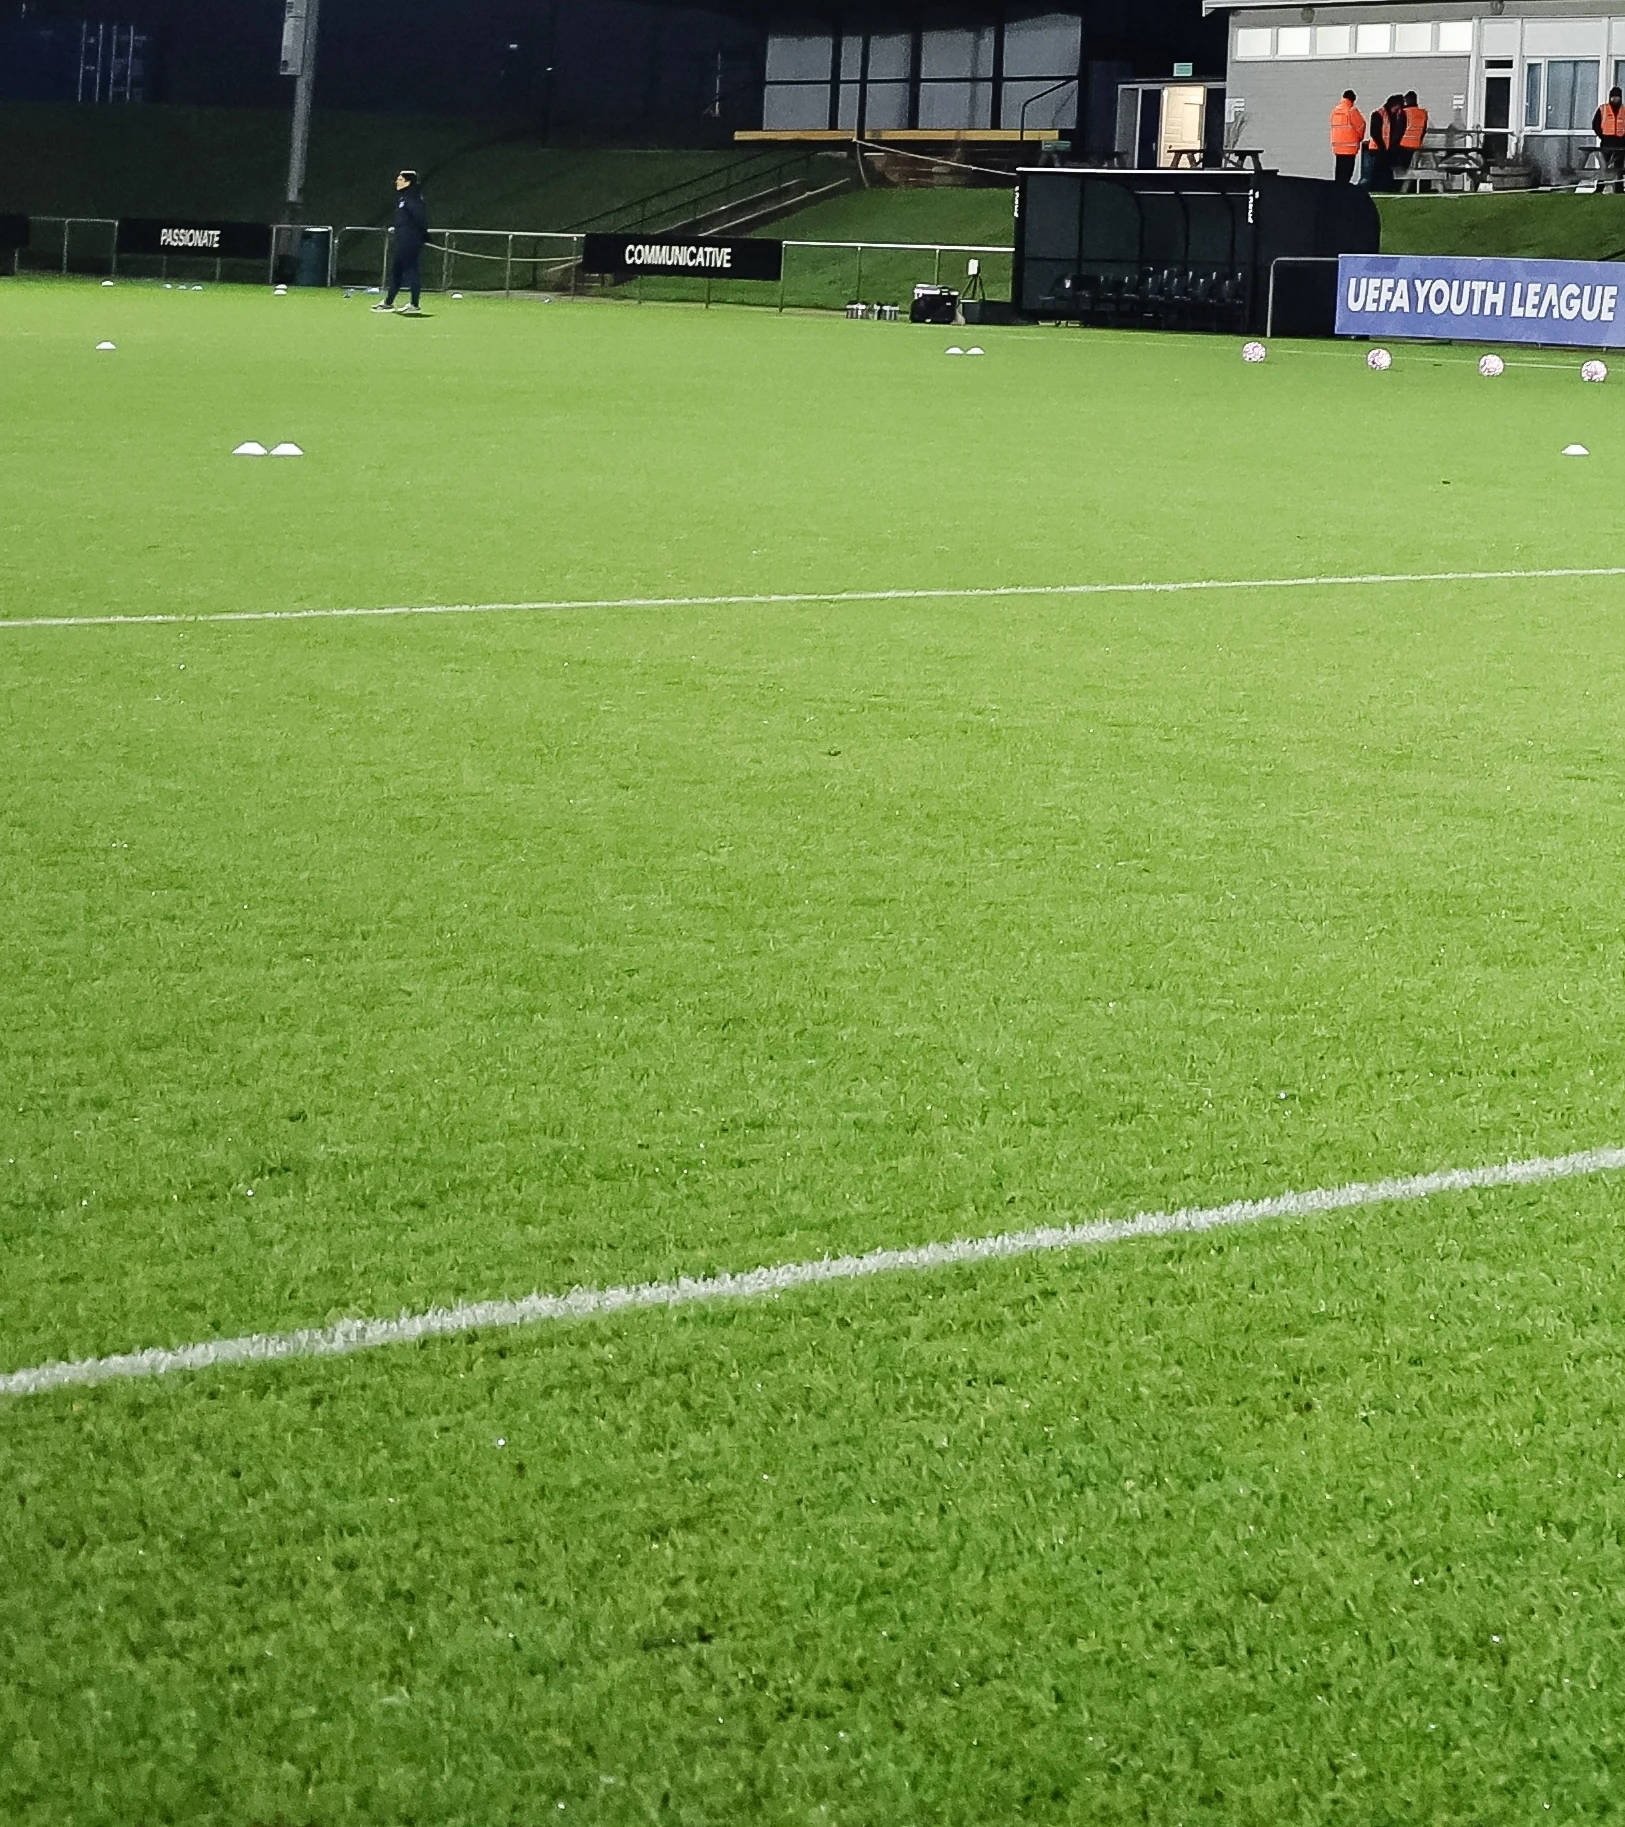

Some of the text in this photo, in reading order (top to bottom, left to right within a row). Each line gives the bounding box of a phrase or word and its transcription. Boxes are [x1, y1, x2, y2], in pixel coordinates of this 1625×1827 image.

[160, 228, 221, 248] PASSIONATE
[624, 244, 732, 268] COMMUNICATIVE
[1348, 277, 1619, 322] UEFA YOUTH LEAGUE
